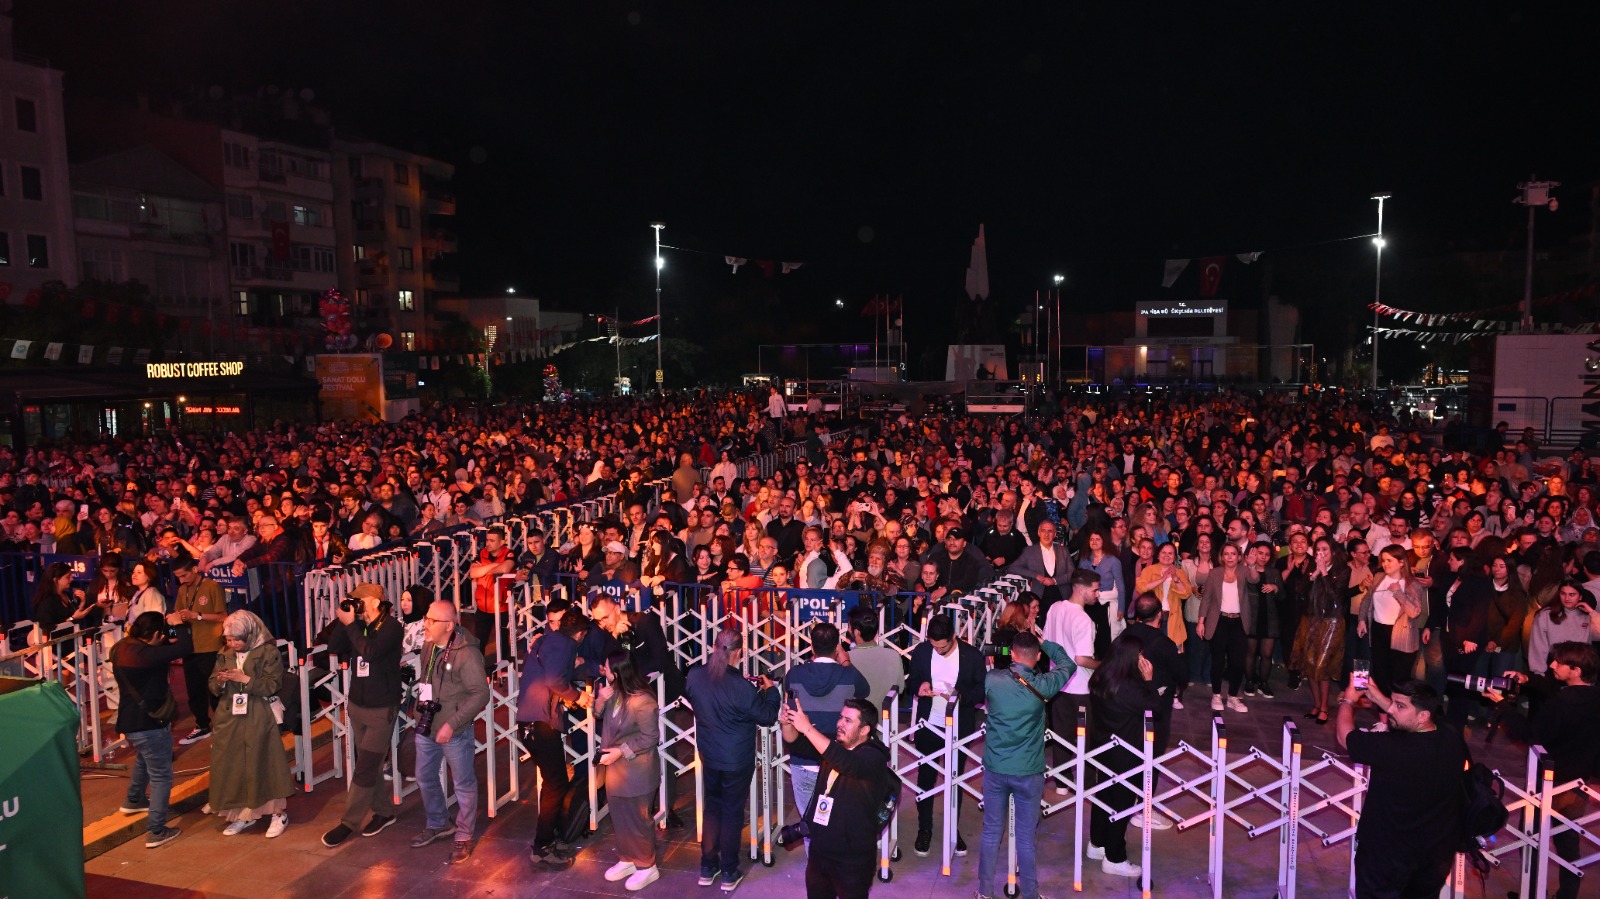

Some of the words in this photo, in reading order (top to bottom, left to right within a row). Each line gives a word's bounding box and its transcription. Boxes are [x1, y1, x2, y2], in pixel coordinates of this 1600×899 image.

[1161, 307, 1193, 315] BÜÜKŞEHİR
[146, 362, 186, 379] ROBUST
[187, 361, 220, 378] COFFEE
[219, 361, 244, 376] SHOP
